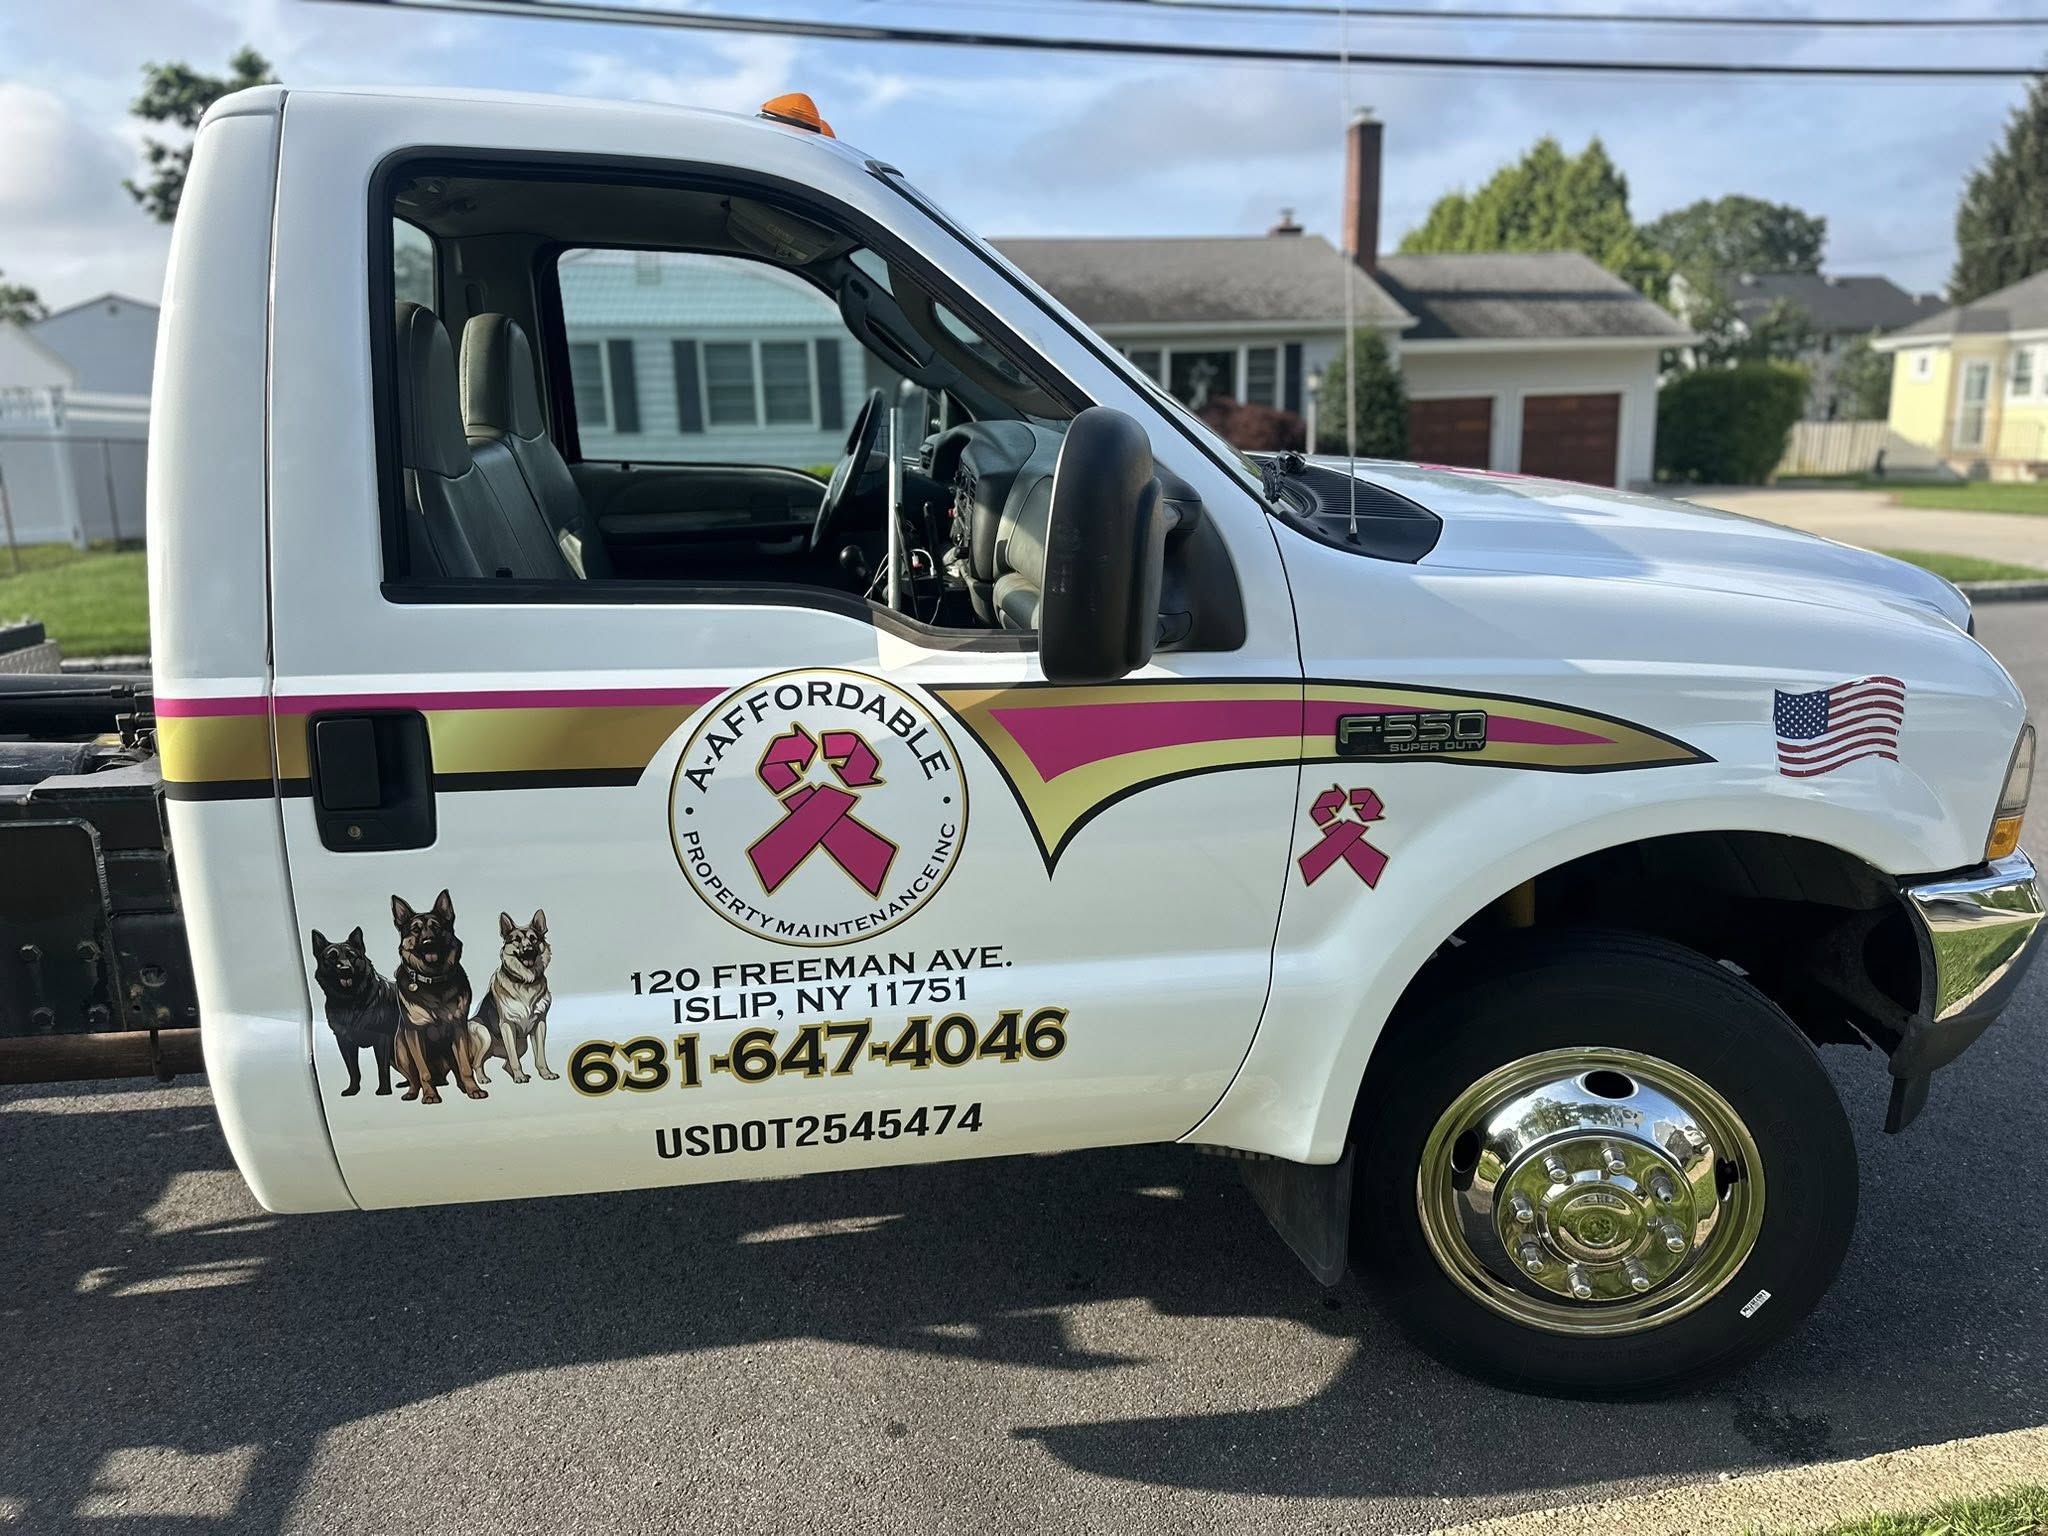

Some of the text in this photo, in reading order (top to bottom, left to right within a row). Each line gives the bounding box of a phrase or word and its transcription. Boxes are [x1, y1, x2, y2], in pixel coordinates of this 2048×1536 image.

[684, 681, 951, 794] A-AFFORDABLE
[1389, 742, 1440, 752] SUPER
[1445, 740, 1485, 750] DUTY
[682, 823, 956, 938] PROPERTY MAINTENANCE INC
[630, 945, 1014, 996] 120 FREEMAN AVE.
[672, 976, 968, 1024] ISLIP, NY 11751
[567, 1007, 1070, 1098] 631-647-4046
[655, 1103, 983, 1159] USDOT2545474
